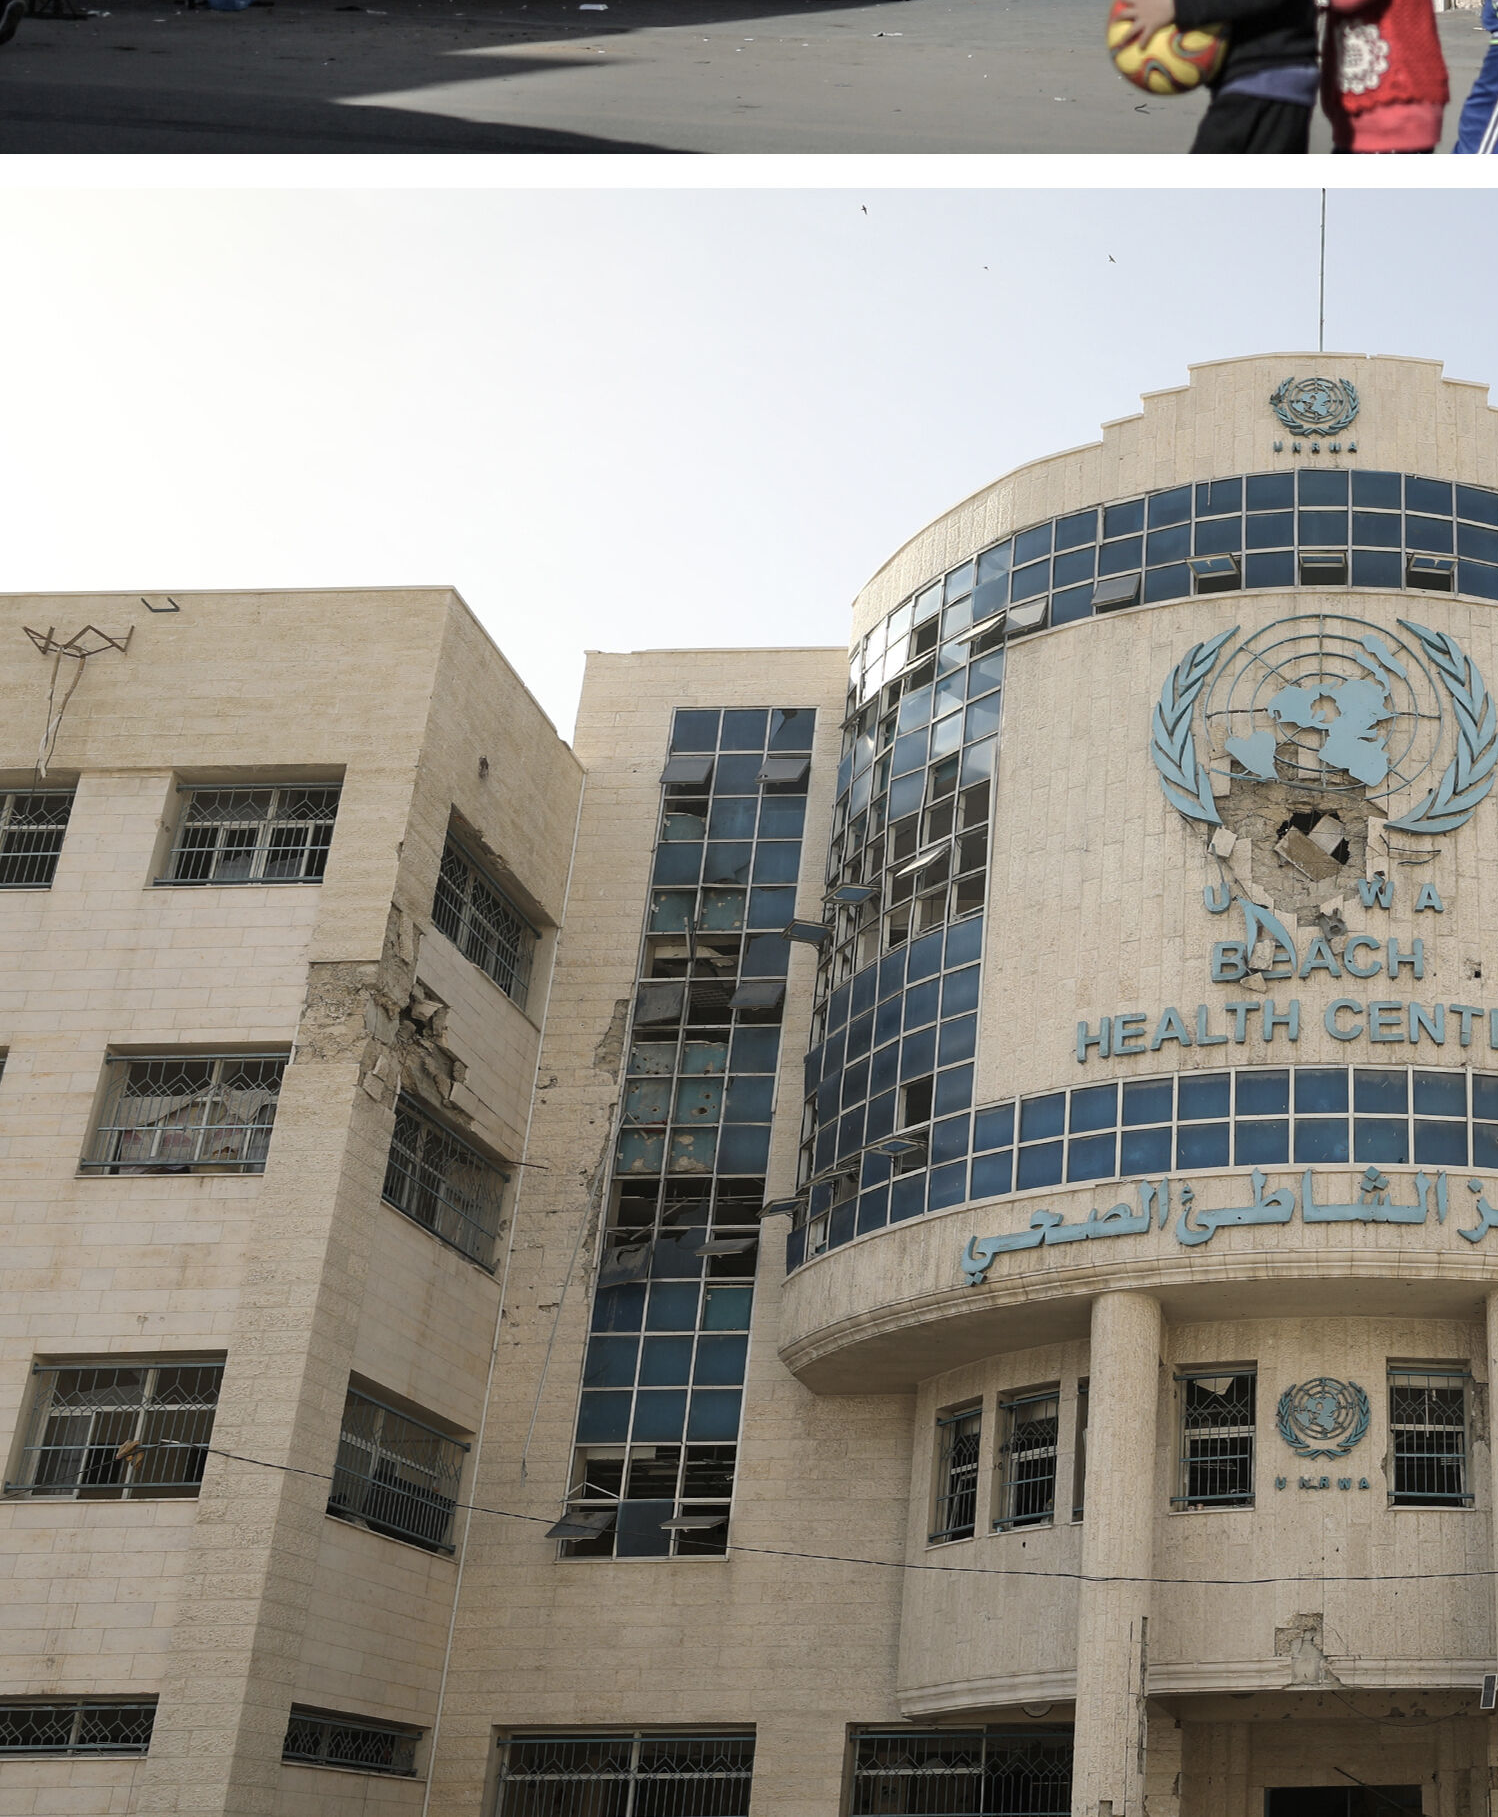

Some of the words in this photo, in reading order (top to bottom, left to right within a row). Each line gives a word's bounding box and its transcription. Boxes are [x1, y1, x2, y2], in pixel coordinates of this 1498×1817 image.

[1273, 440, 1358, 455] UNRWA
[1203, 877, 1445, 914] UWA
[1076, 999, 1301, 1063] HEALTH
[960, 1177, 1169, 1287] الصحي
[1176, 1165, 1448, 1247] الشاطئ
